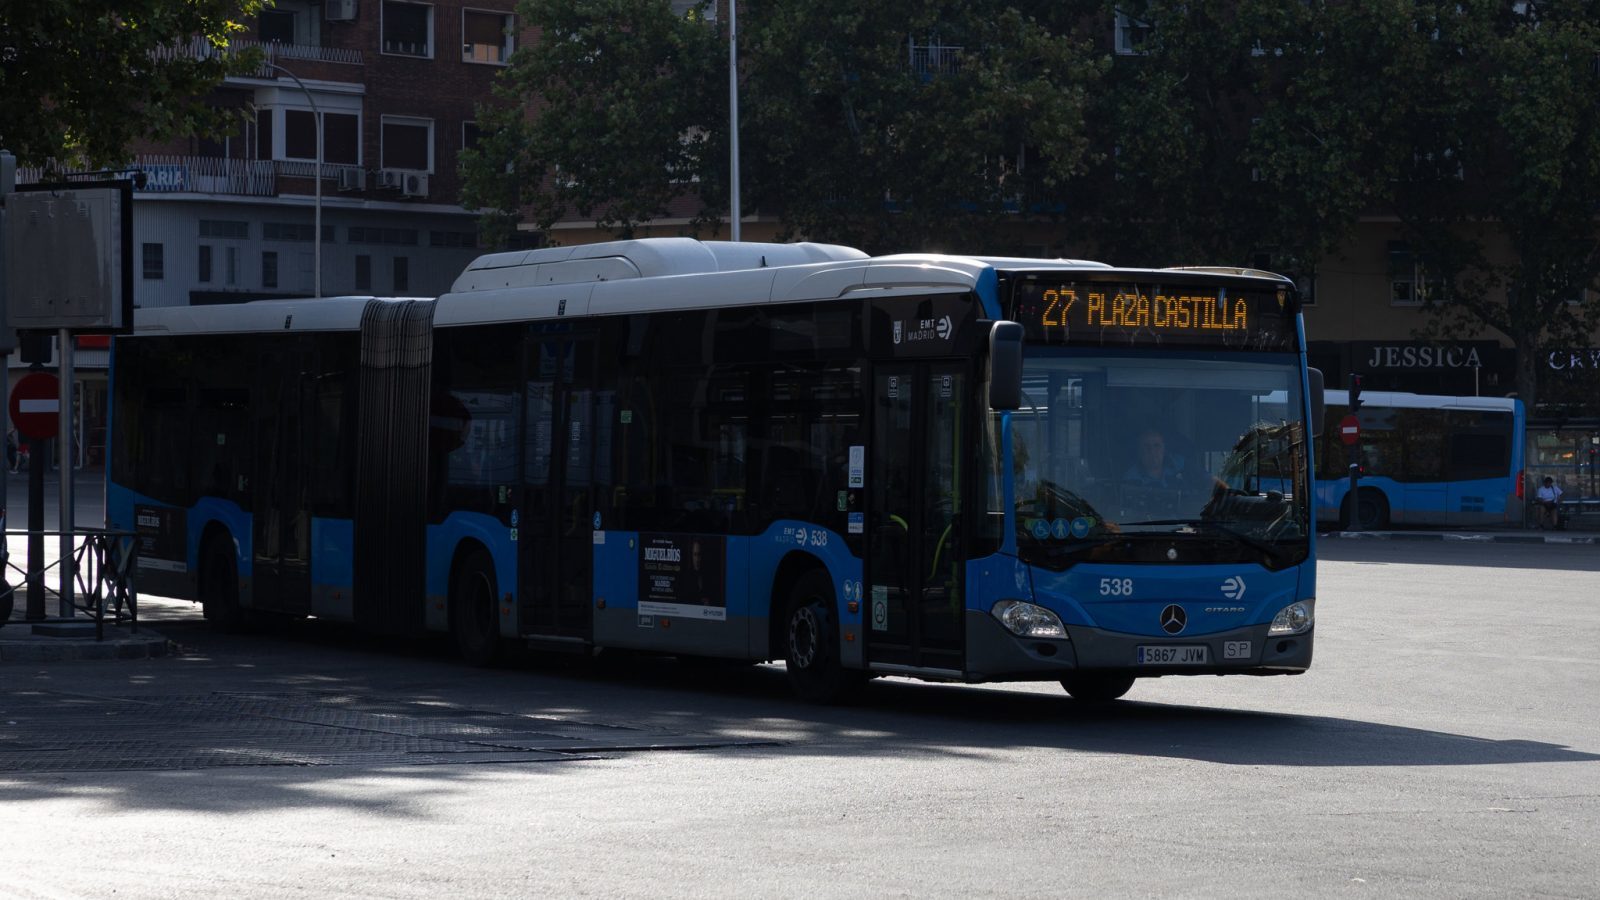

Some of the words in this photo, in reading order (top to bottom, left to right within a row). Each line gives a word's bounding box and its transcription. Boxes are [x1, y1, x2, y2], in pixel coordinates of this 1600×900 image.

[1042, 289, 1076, 326] 27
[1087, 293, 1149, 327] PLAZA
[1153, 296, 1248, 329] CASTILLA
[920, 319, 935, 329] EMT
[908, 329, 935, 341] MADRID
[1368, 346, 1483, 368] JESSICA
[811, 530, 828, 546] 538
[1100, 578, 1133, 596] 538
[1146, 648, 1177, 662] 5867
[1181, 648, 1204, 662] JVM
[1227, 643, 1248, 657] SP
